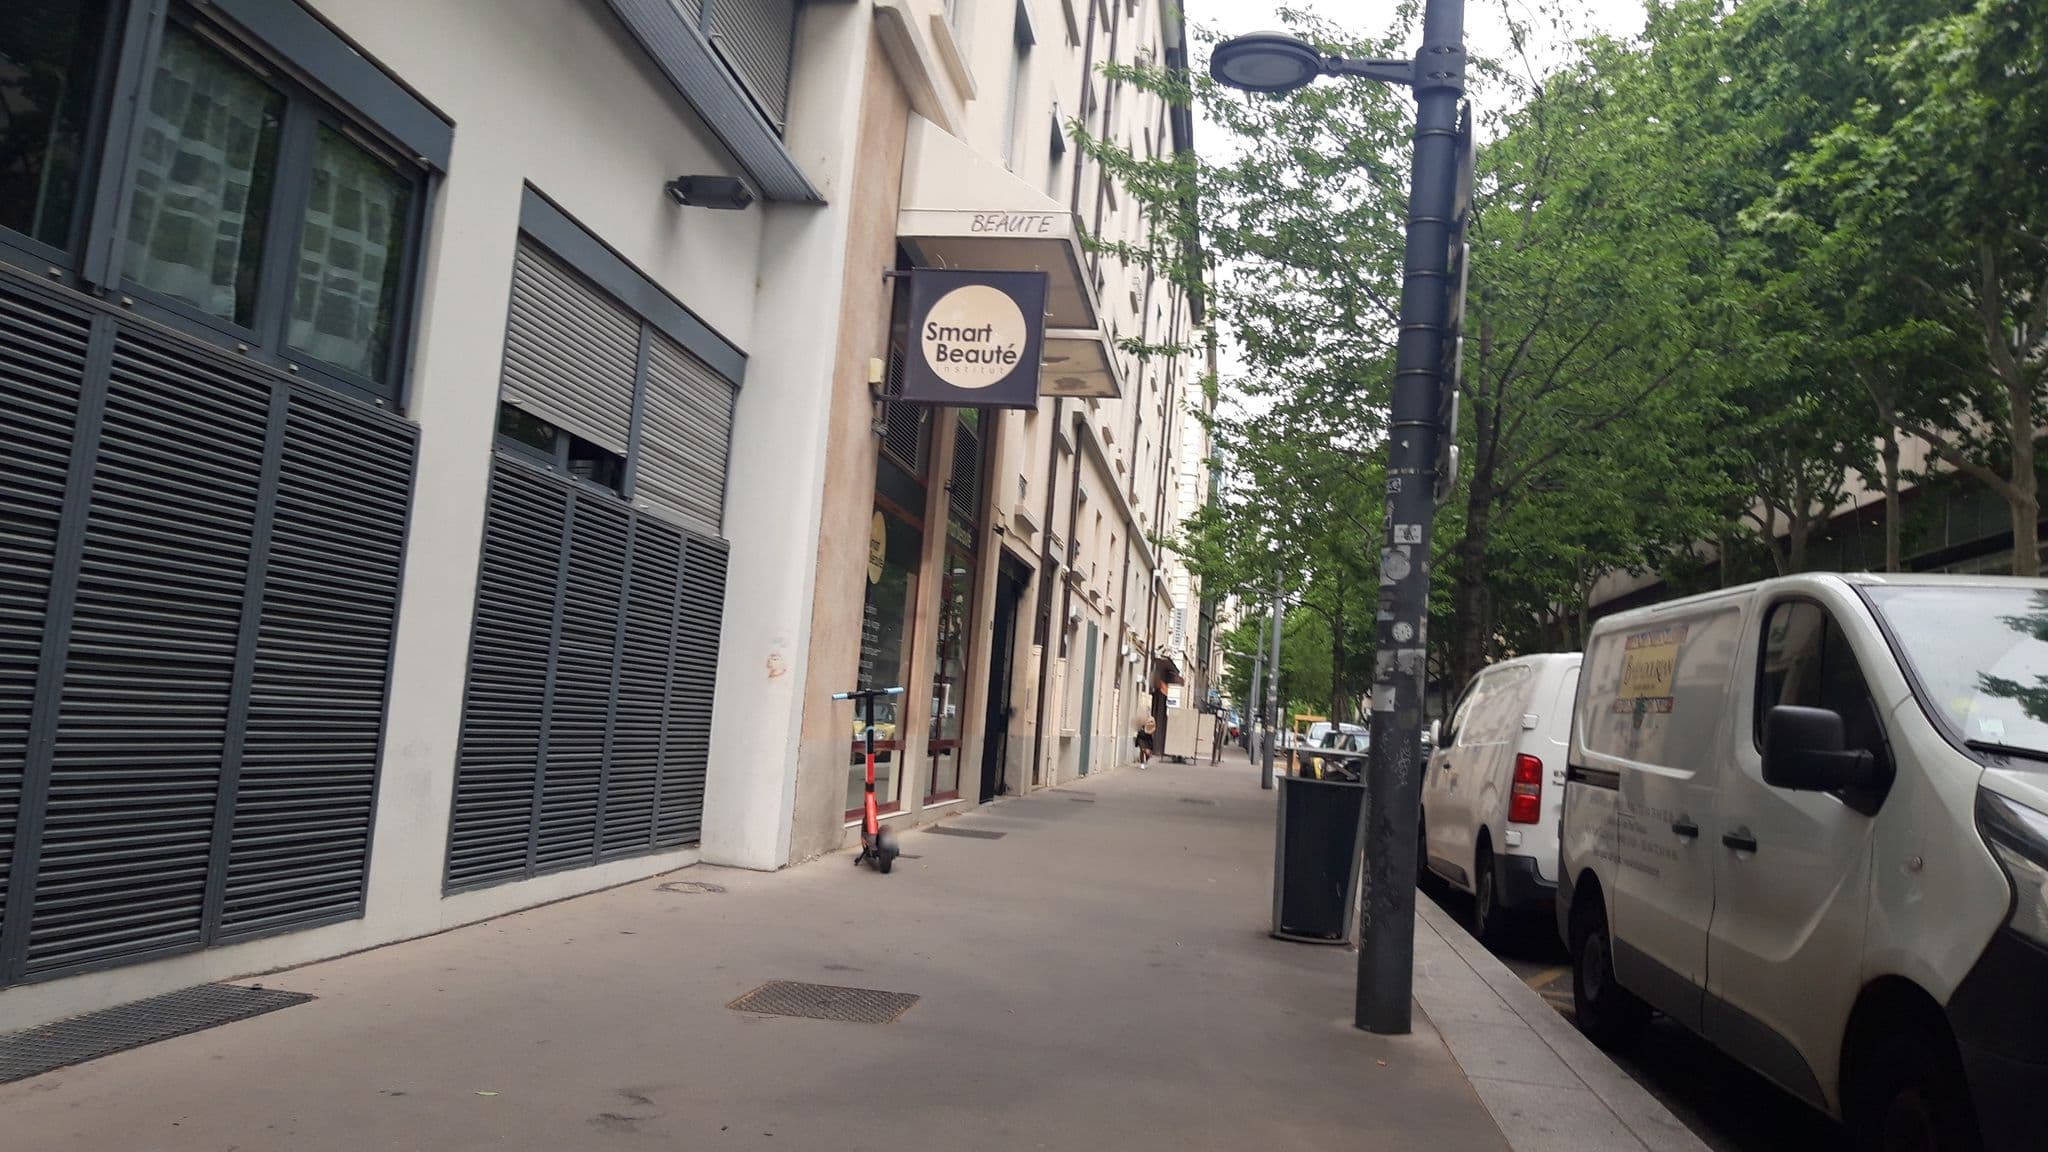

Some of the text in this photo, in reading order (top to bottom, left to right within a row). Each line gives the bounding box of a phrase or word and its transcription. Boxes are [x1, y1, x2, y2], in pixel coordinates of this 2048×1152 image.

[970, 214, 1054, 233] BEAUTE
[926, 321, 993, 343] Smart
[936, 343, 1017, 365] Beauté
[936, 365, 1005, 375] institut
